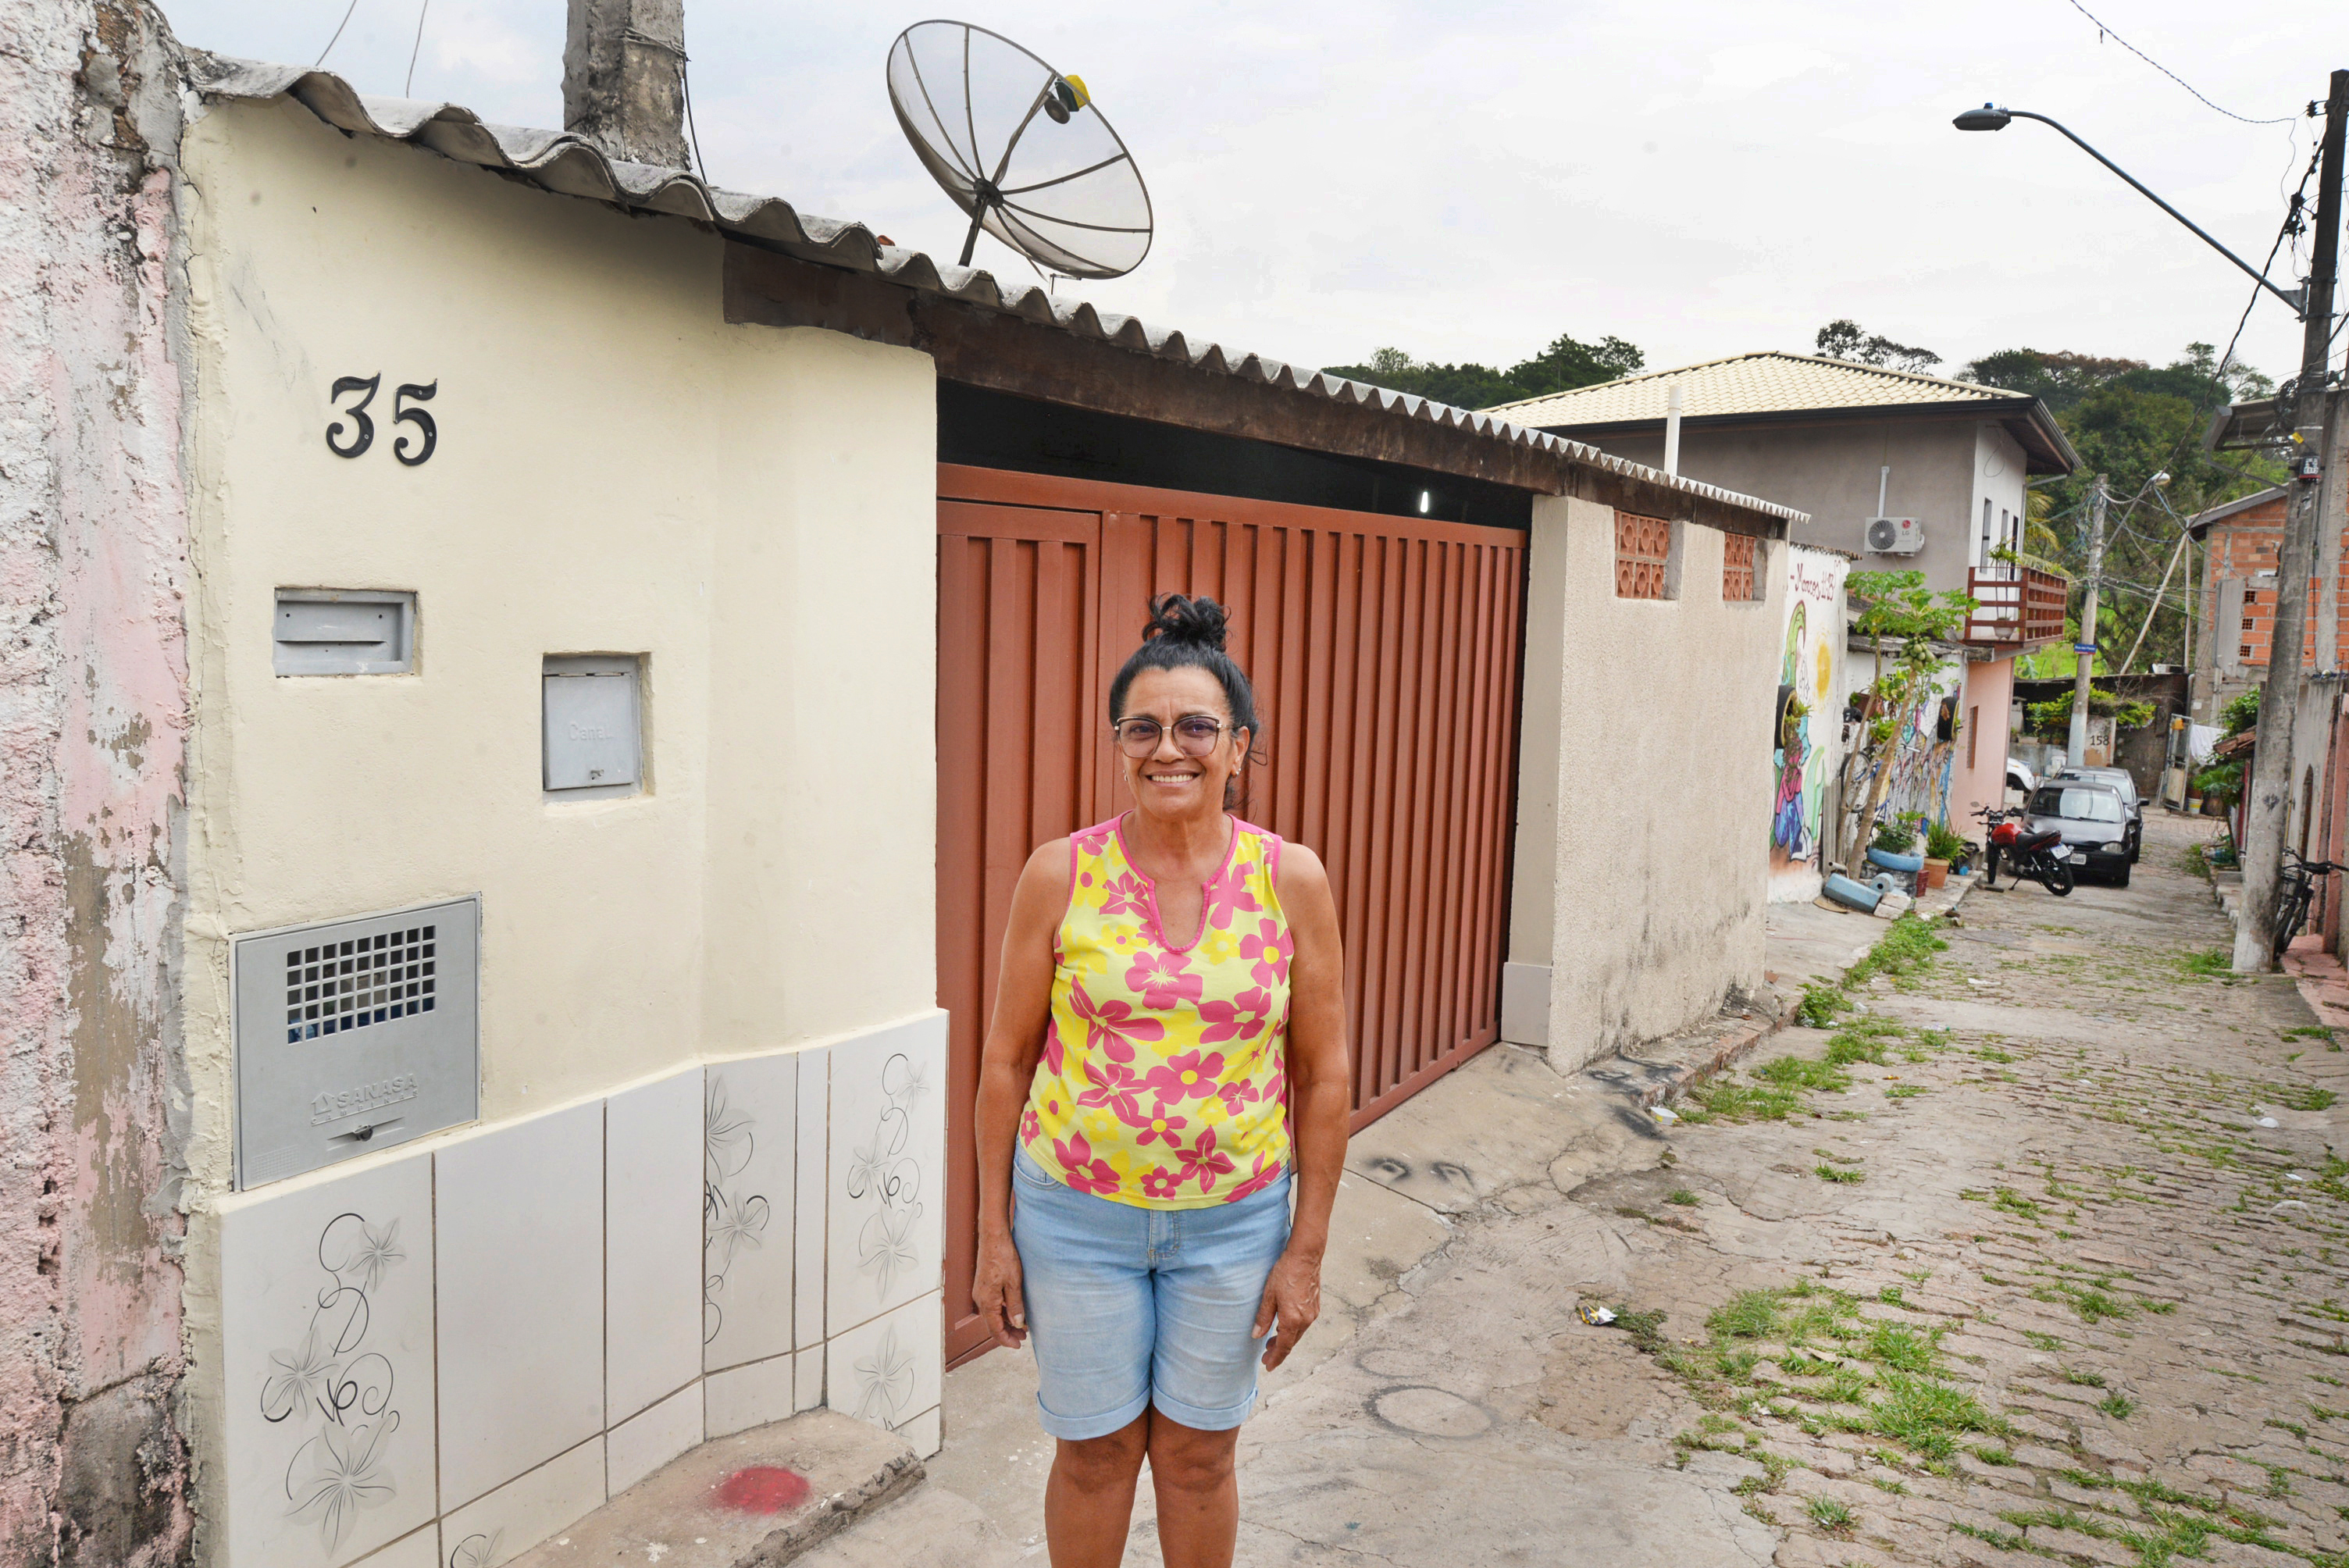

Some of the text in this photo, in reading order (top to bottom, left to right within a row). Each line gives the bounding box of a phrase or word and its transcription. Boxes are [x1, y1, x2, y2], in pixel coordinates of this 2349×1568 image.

[326, 370, 437, 466] 35
[2090, 735, 2110, 746] 158
[337, 1073, 418, 1109] SANASA
